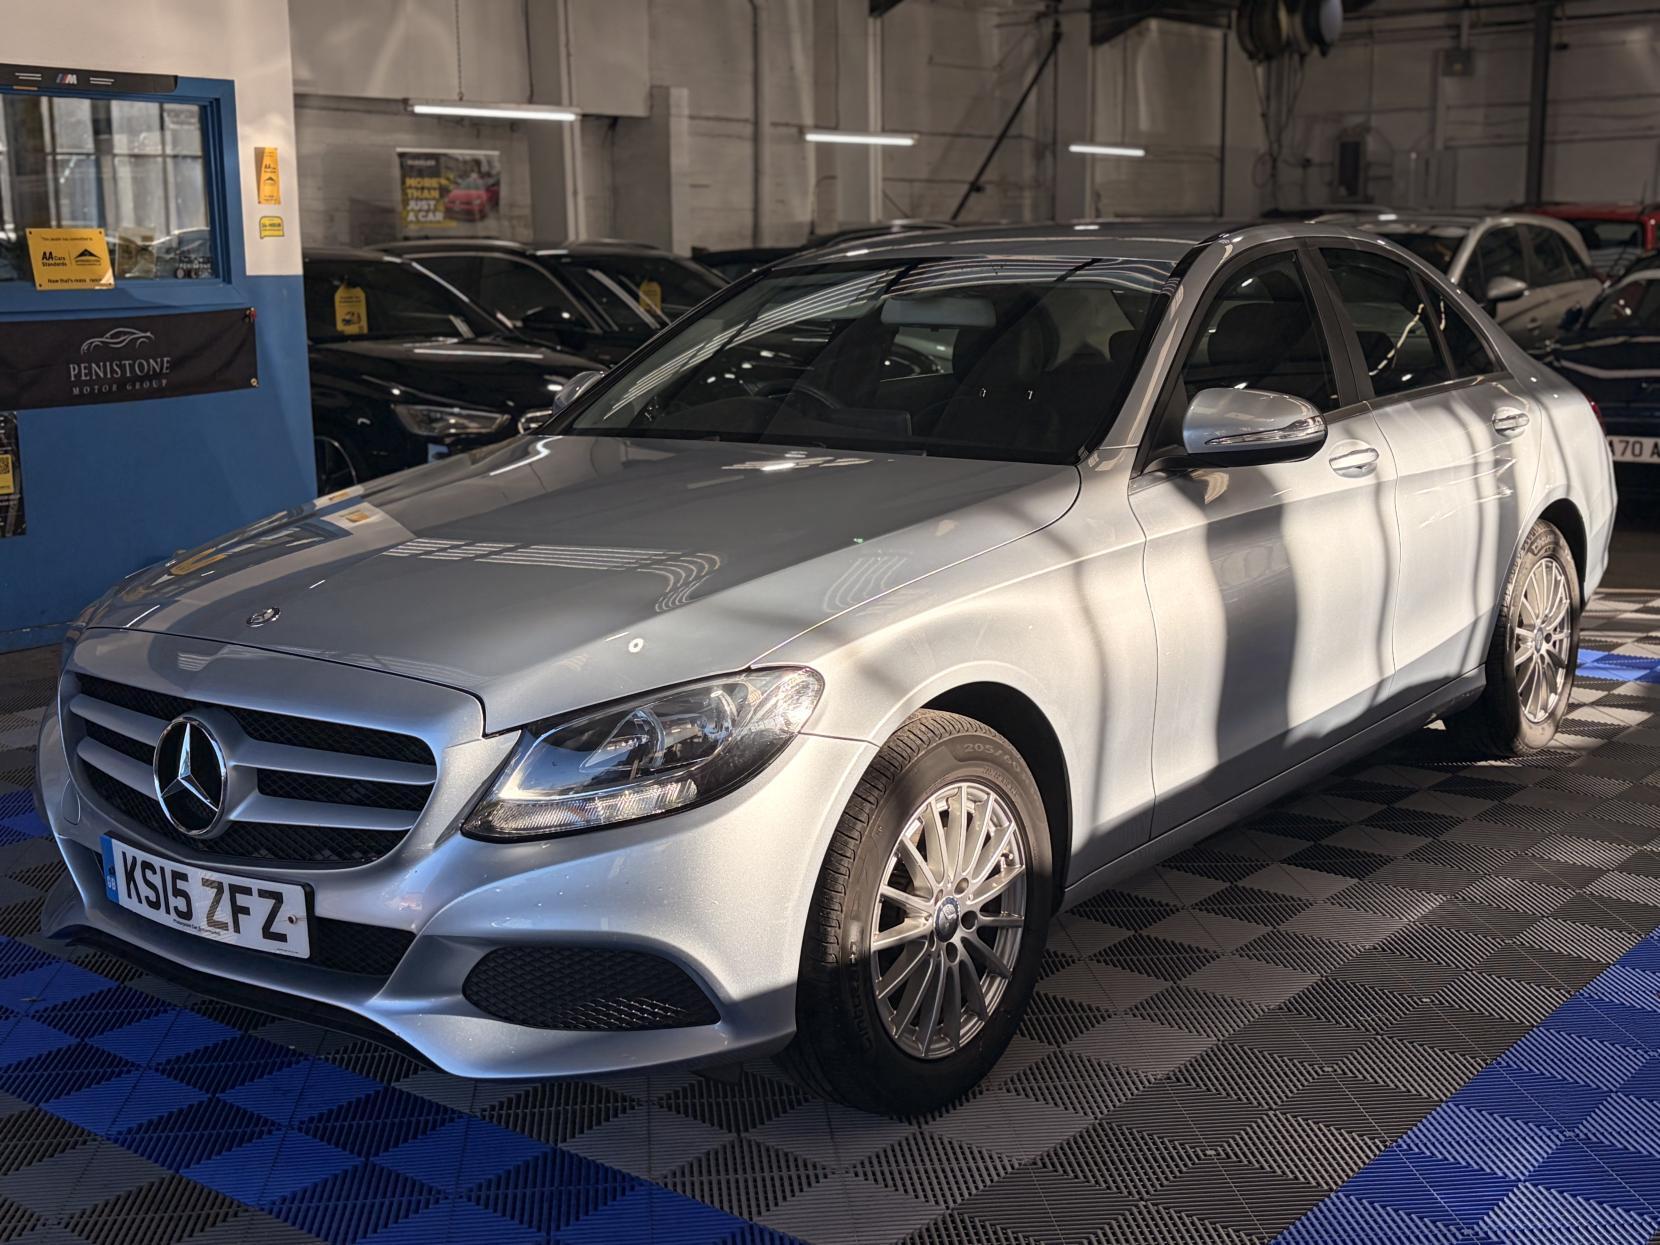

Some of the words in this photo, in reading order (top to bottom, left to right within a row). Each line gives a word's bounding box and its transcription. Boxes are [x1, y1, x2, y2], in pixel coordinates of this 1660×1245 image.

[405, 177, 441, 188] MORE
[406, 189, 440, 199] THAN
[407, 200, 436, 211] JUST
[407, 211, 417, 221] A
[418, 211, 444, 221] CAR
[42, 251, 54, 261] AA
[69, 357, 171, 381] PENISTONE
[72, 384, 117, 395] MOTOR
[126, 379, 167, 390] GROUP
[121, 851, 193, 922] KS15
[202, 877, 288, 943] ZFZ
